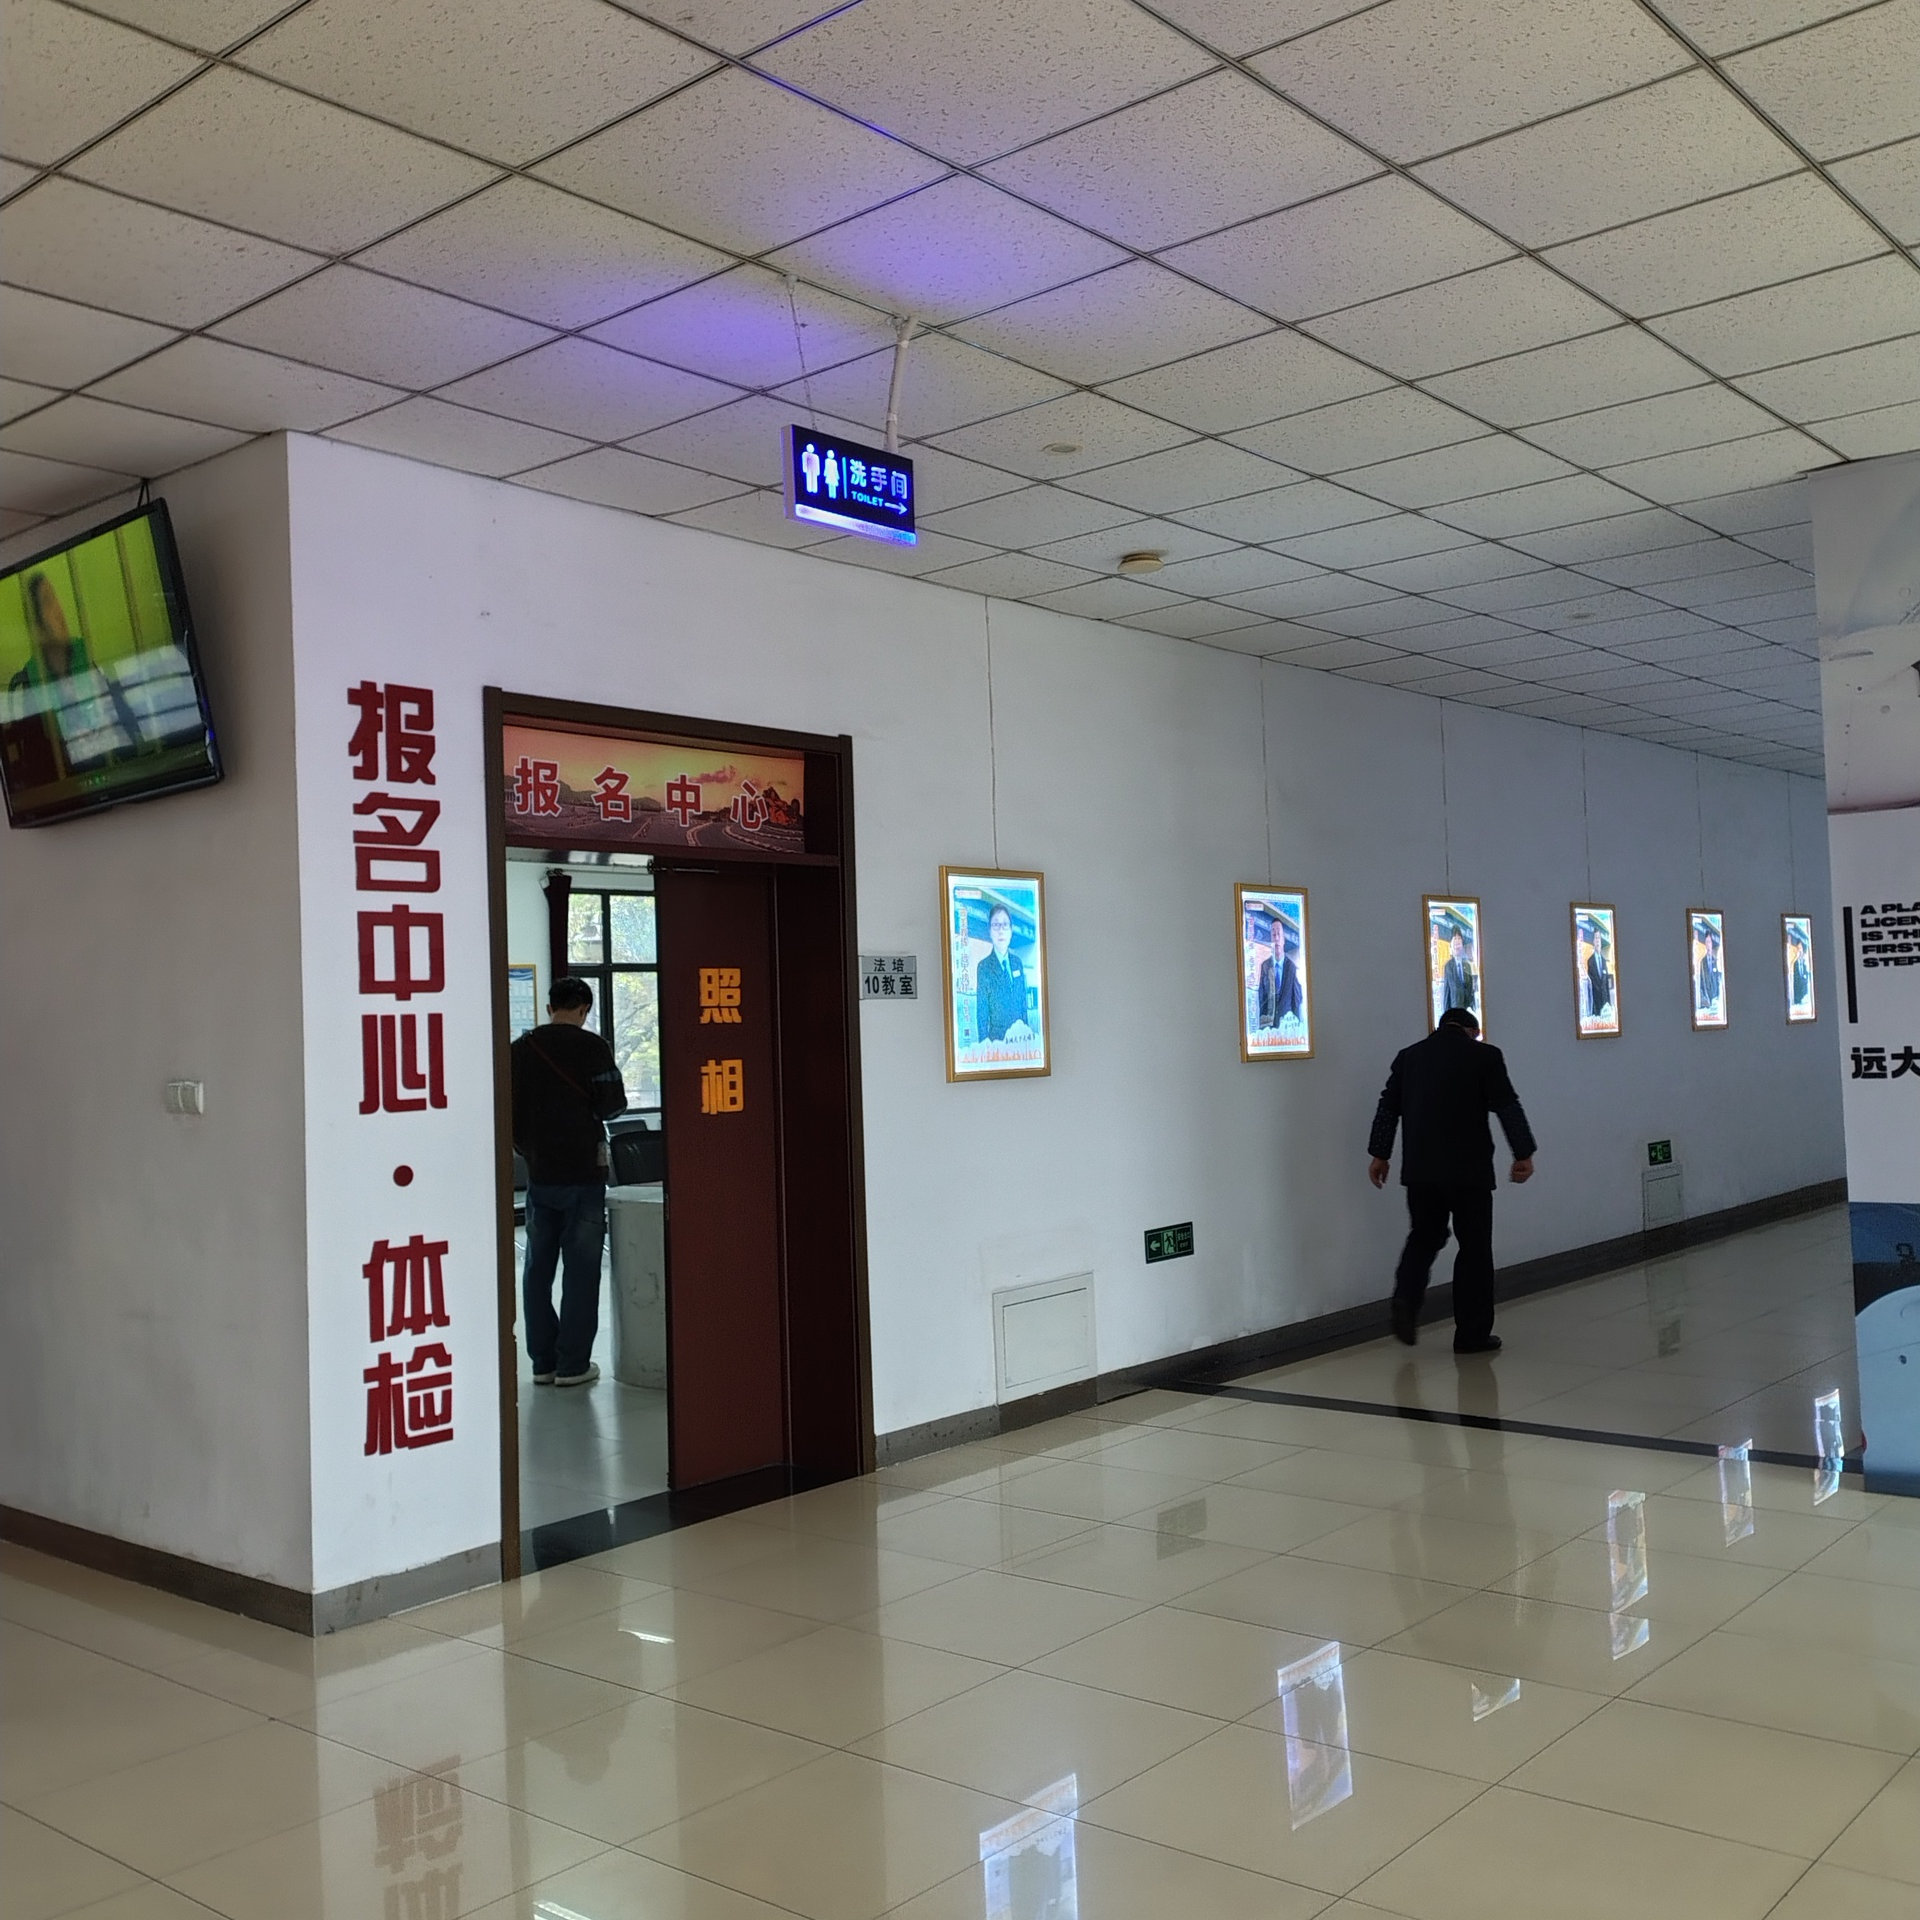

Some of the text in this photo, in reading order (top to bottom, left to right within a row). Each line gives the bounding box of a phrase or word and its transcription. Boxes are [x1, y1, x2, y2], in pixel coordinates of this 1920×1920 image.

[849, 458, 908, 500] 洗手间
[850, 490, 884, 507] TOILET
[513, 755, 769, 831] 报名中心
[1860, 904, 1878, 916] A
[1861, 930, 1884, 942] IS
[873, 958, 905, 973] 法培
[864, 975, 914, 995] 10教室
[699, 967, 745, 1116] 照相
[1850, 1045, 1920, 1080] 远大
